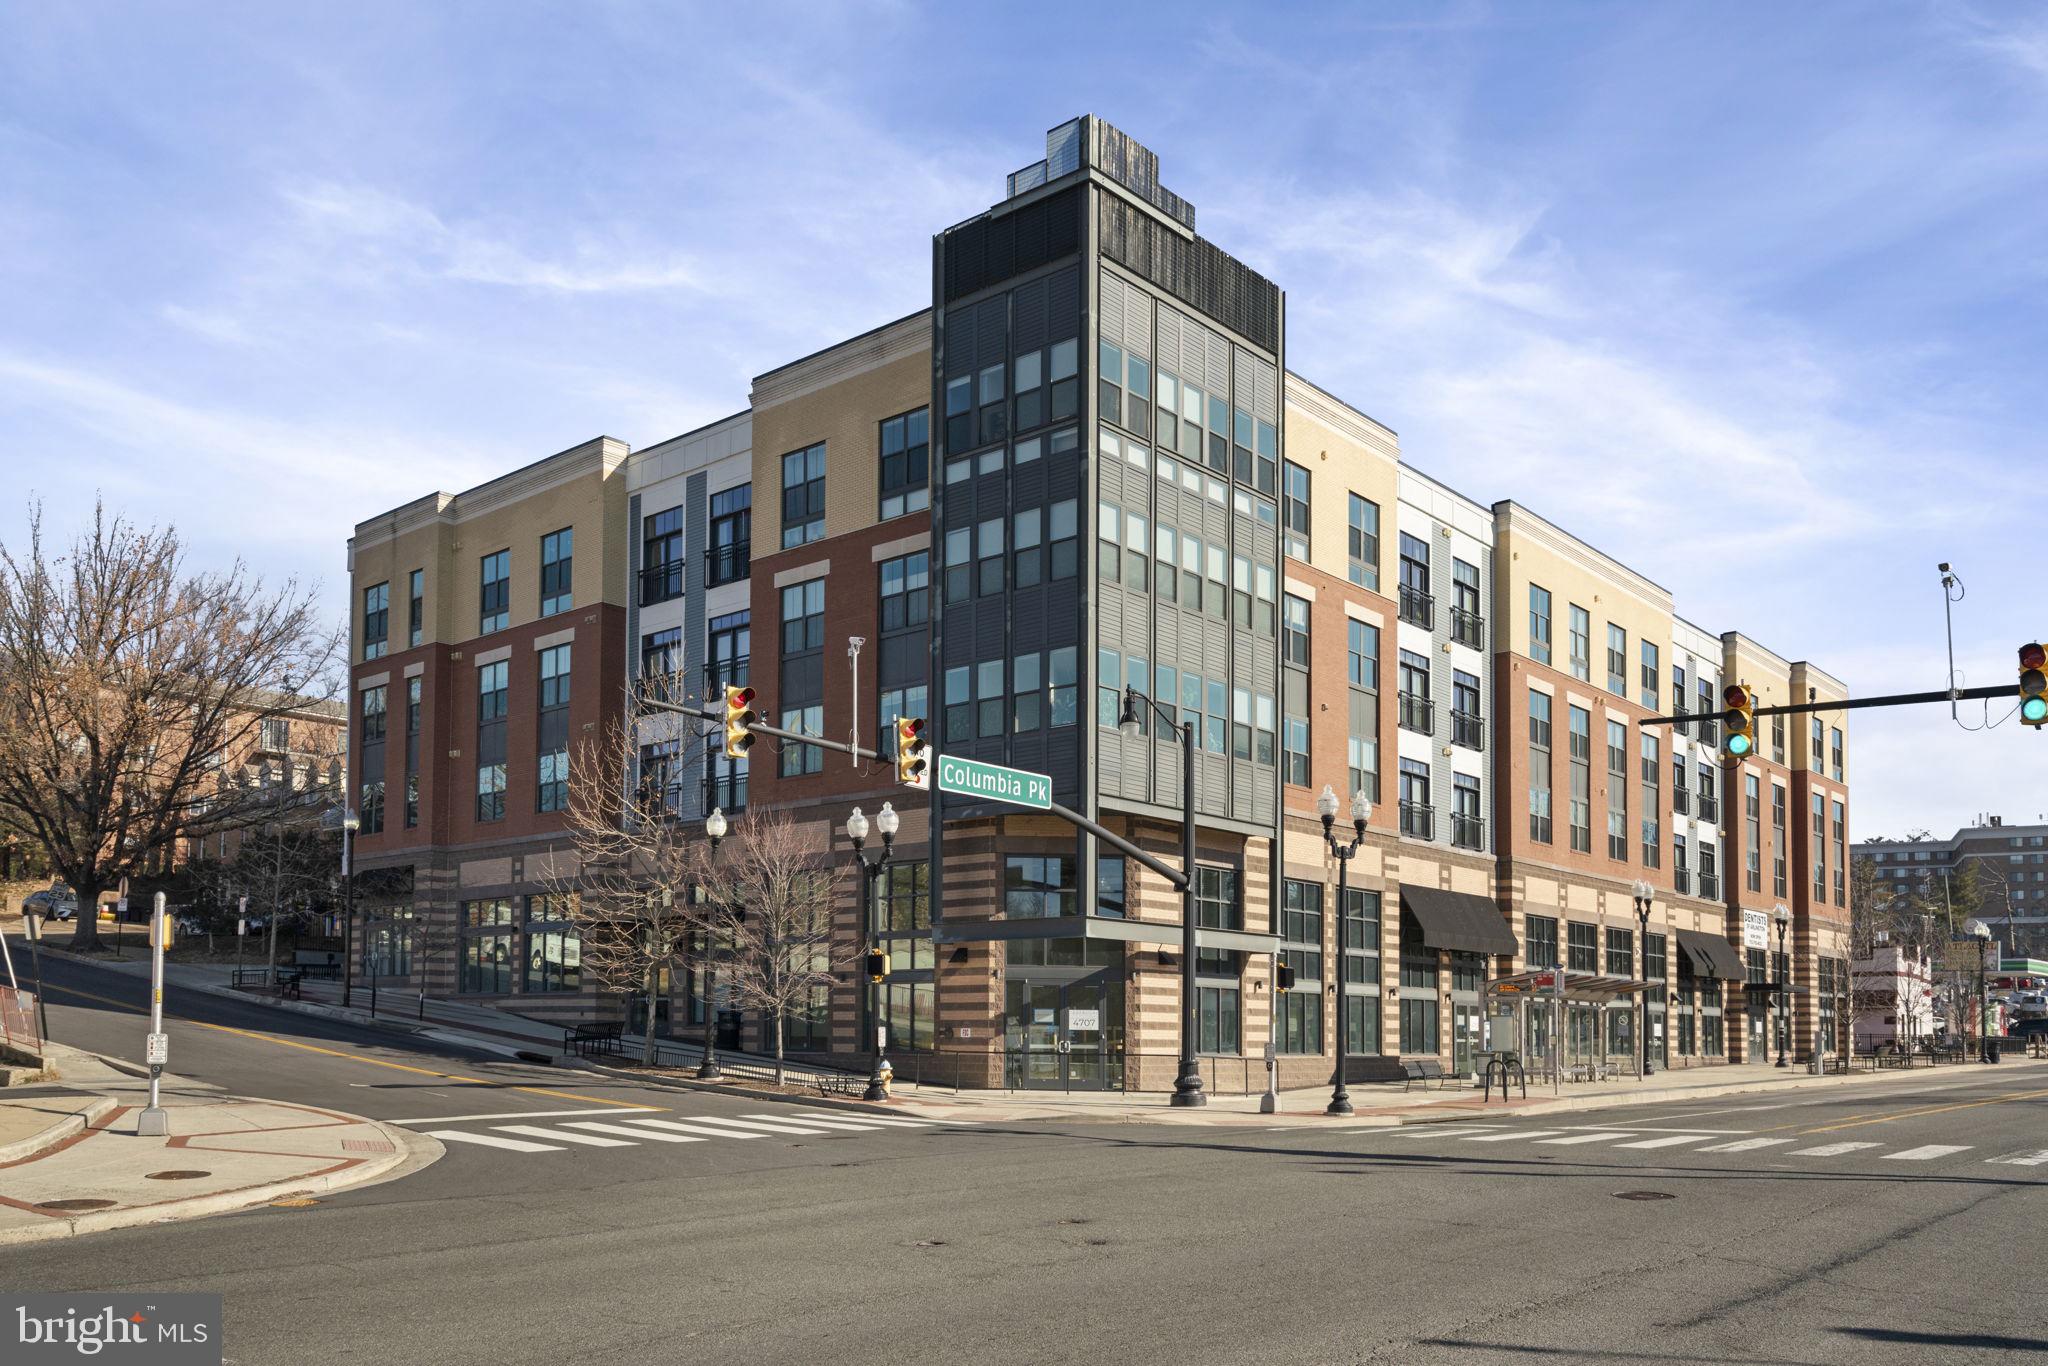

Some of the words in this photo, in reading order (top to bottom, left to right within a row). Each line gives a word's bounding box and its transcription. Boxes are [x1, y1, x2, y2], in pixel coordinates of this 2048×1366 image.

[944, 764, 1021, 796] Columbia
[1029, 781, 1047, 800] Pk
[49, 890, 65, 899] 25
[1744, 912, 1766, 926] DENTISTS
[1072, 1018, 1096, 1028] 4707
